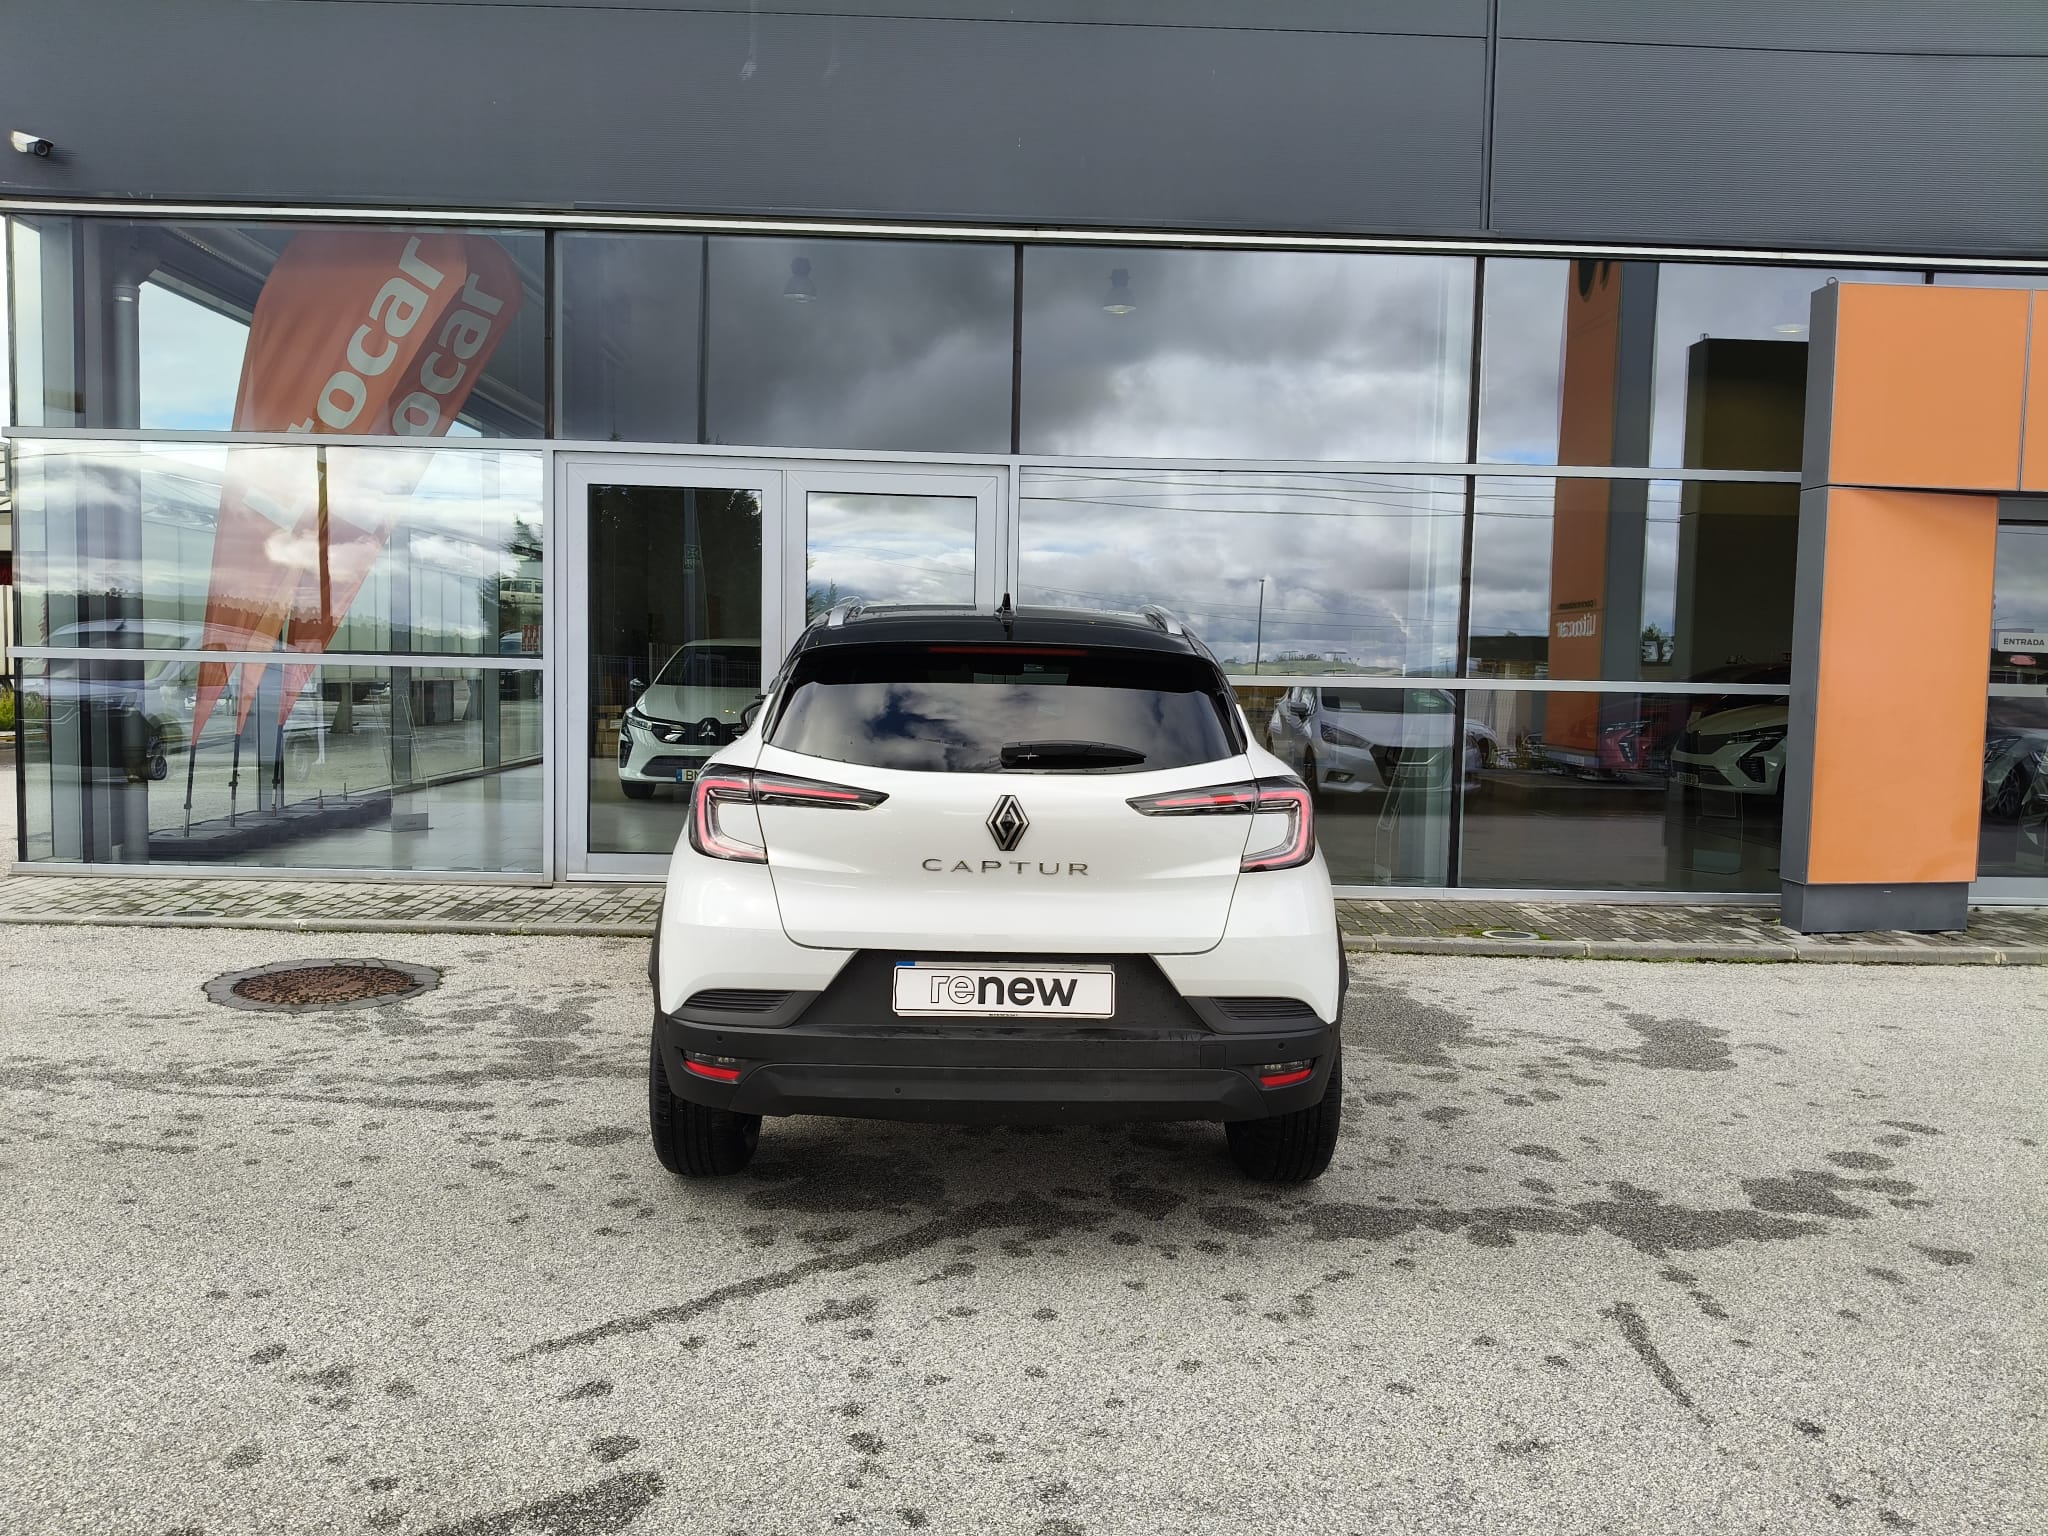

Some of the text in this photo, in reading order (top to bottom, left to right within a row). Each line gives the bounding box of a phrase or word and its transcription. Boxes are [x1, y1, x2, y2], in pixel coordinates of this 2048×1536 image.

[2003, 638, 2045, 646] ENTRADA
[921, 858, 1089, 875] CAPTUR
[930, 975, 1078, 1006] renew
